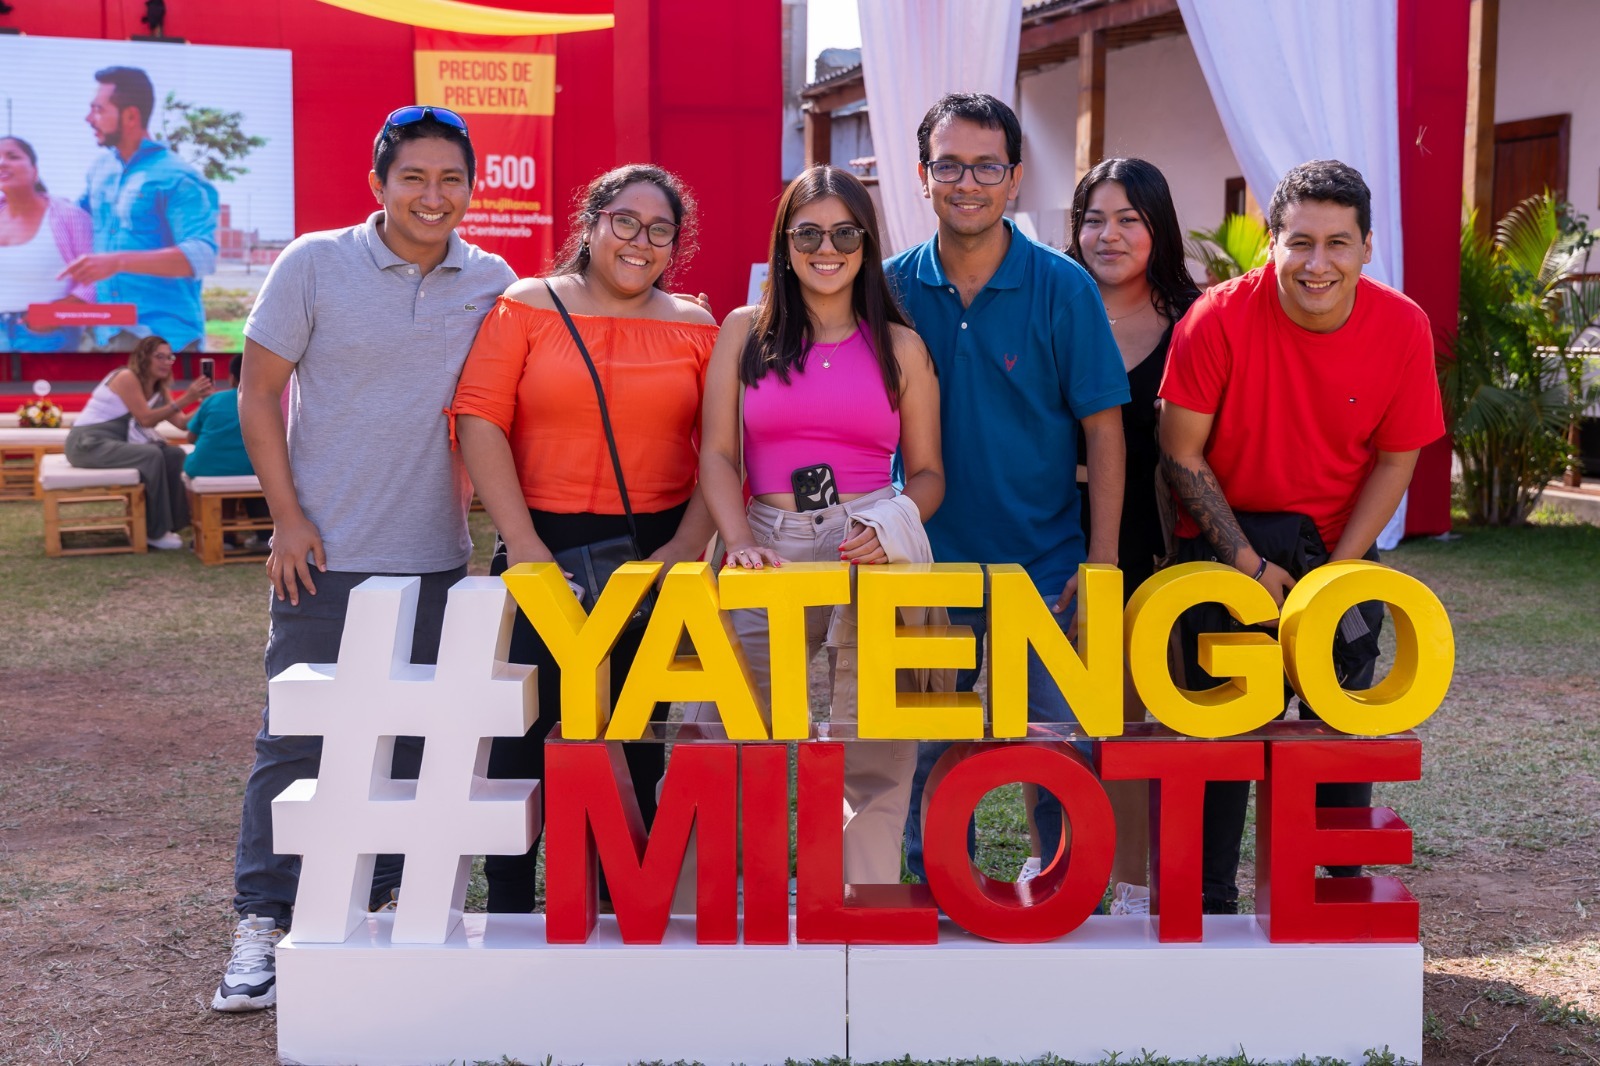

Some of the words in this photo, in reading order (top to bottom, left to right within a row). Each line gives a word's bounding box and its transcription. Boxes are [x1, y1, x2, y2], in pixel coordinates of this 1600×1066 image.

[439, 60, 508, 82] PRECIOS
[513, 62, 533, 83] DE
[444, 86, 529, 108] PREVENTA
[477, 154, 536, 192] ,500
[467, 224, 533, 238] Centenario
